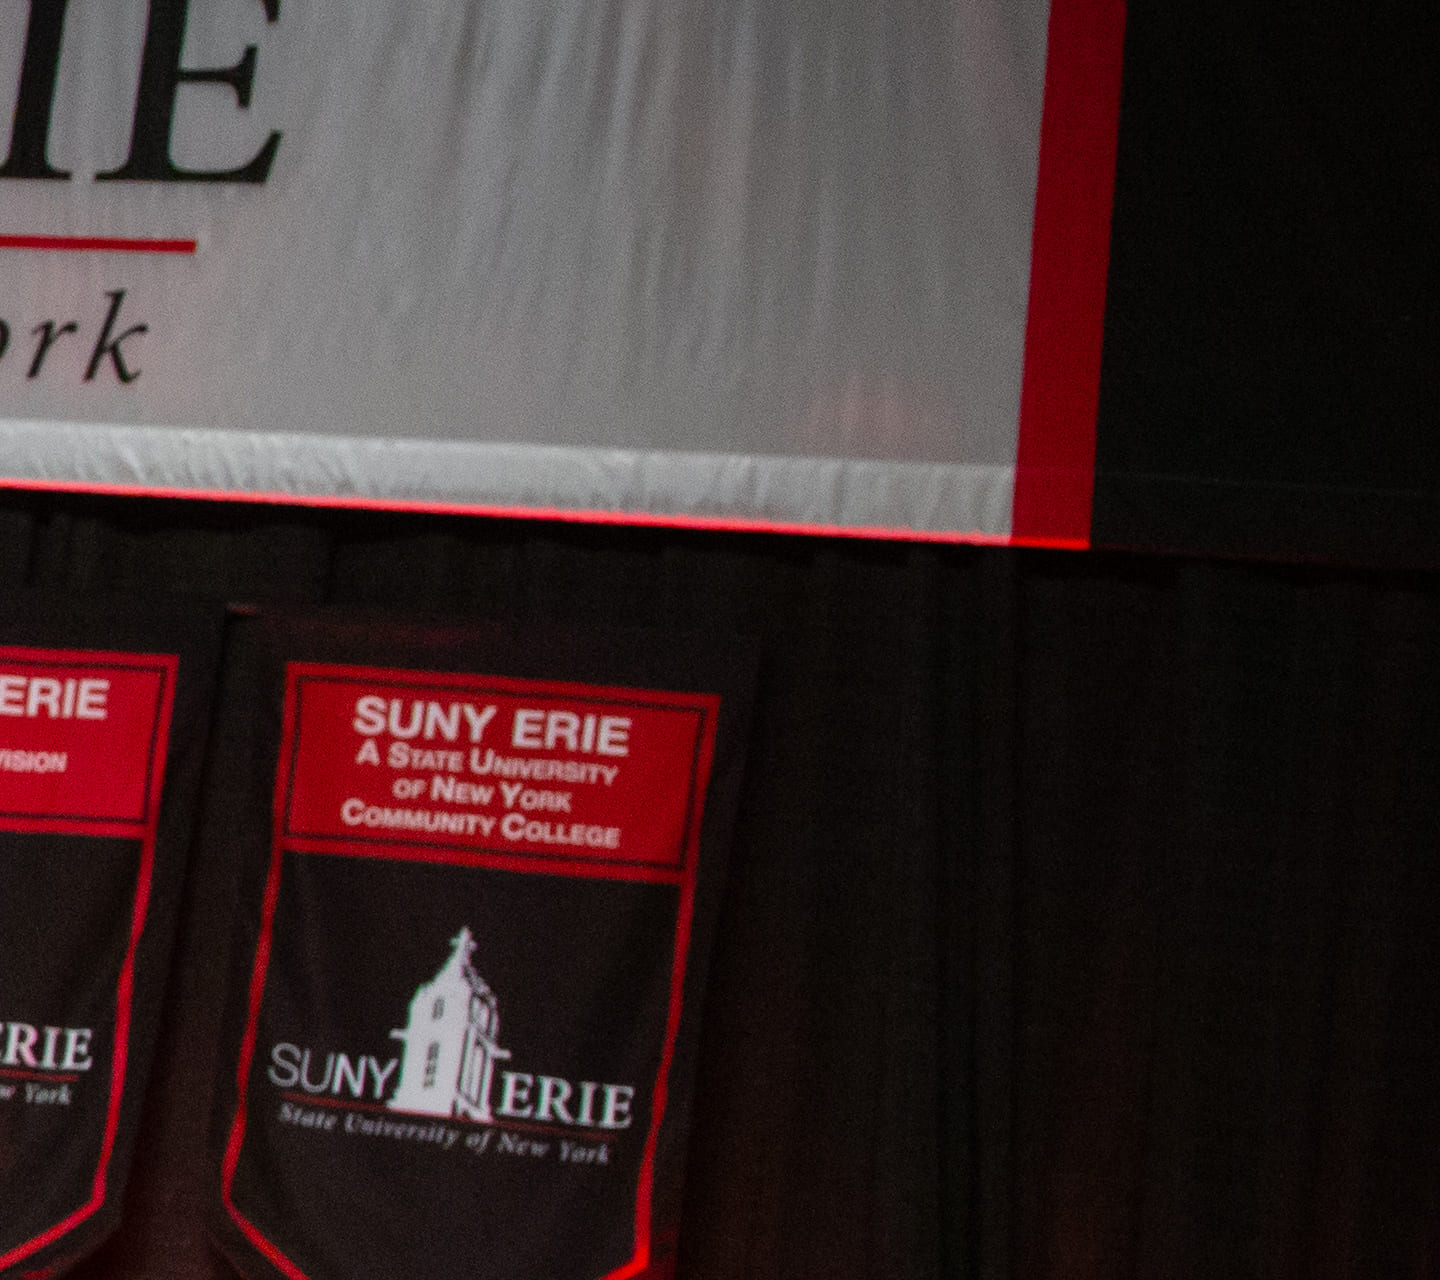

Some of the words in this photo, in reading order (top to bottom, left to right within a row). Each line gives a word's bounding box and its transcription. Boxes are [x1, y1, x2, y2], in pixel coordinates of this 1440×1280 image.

[352, 694, 497, 743] SUNY
[510, 707, 632, 757] ERIE
[355, 738, 381, 767] A
[24, 1082, 72, 1106] York
[266, 1041, 399, 1100] SUNY
[497, 1070, 635, 1130] ERIE
[278, 1102, 338, 1130] State
[342, 1109, 459, 1150] University
[464, 1128, 493, 1155] of
[495, 1131, 551, 1158] New
[558, 1139, 610, 1166] York
